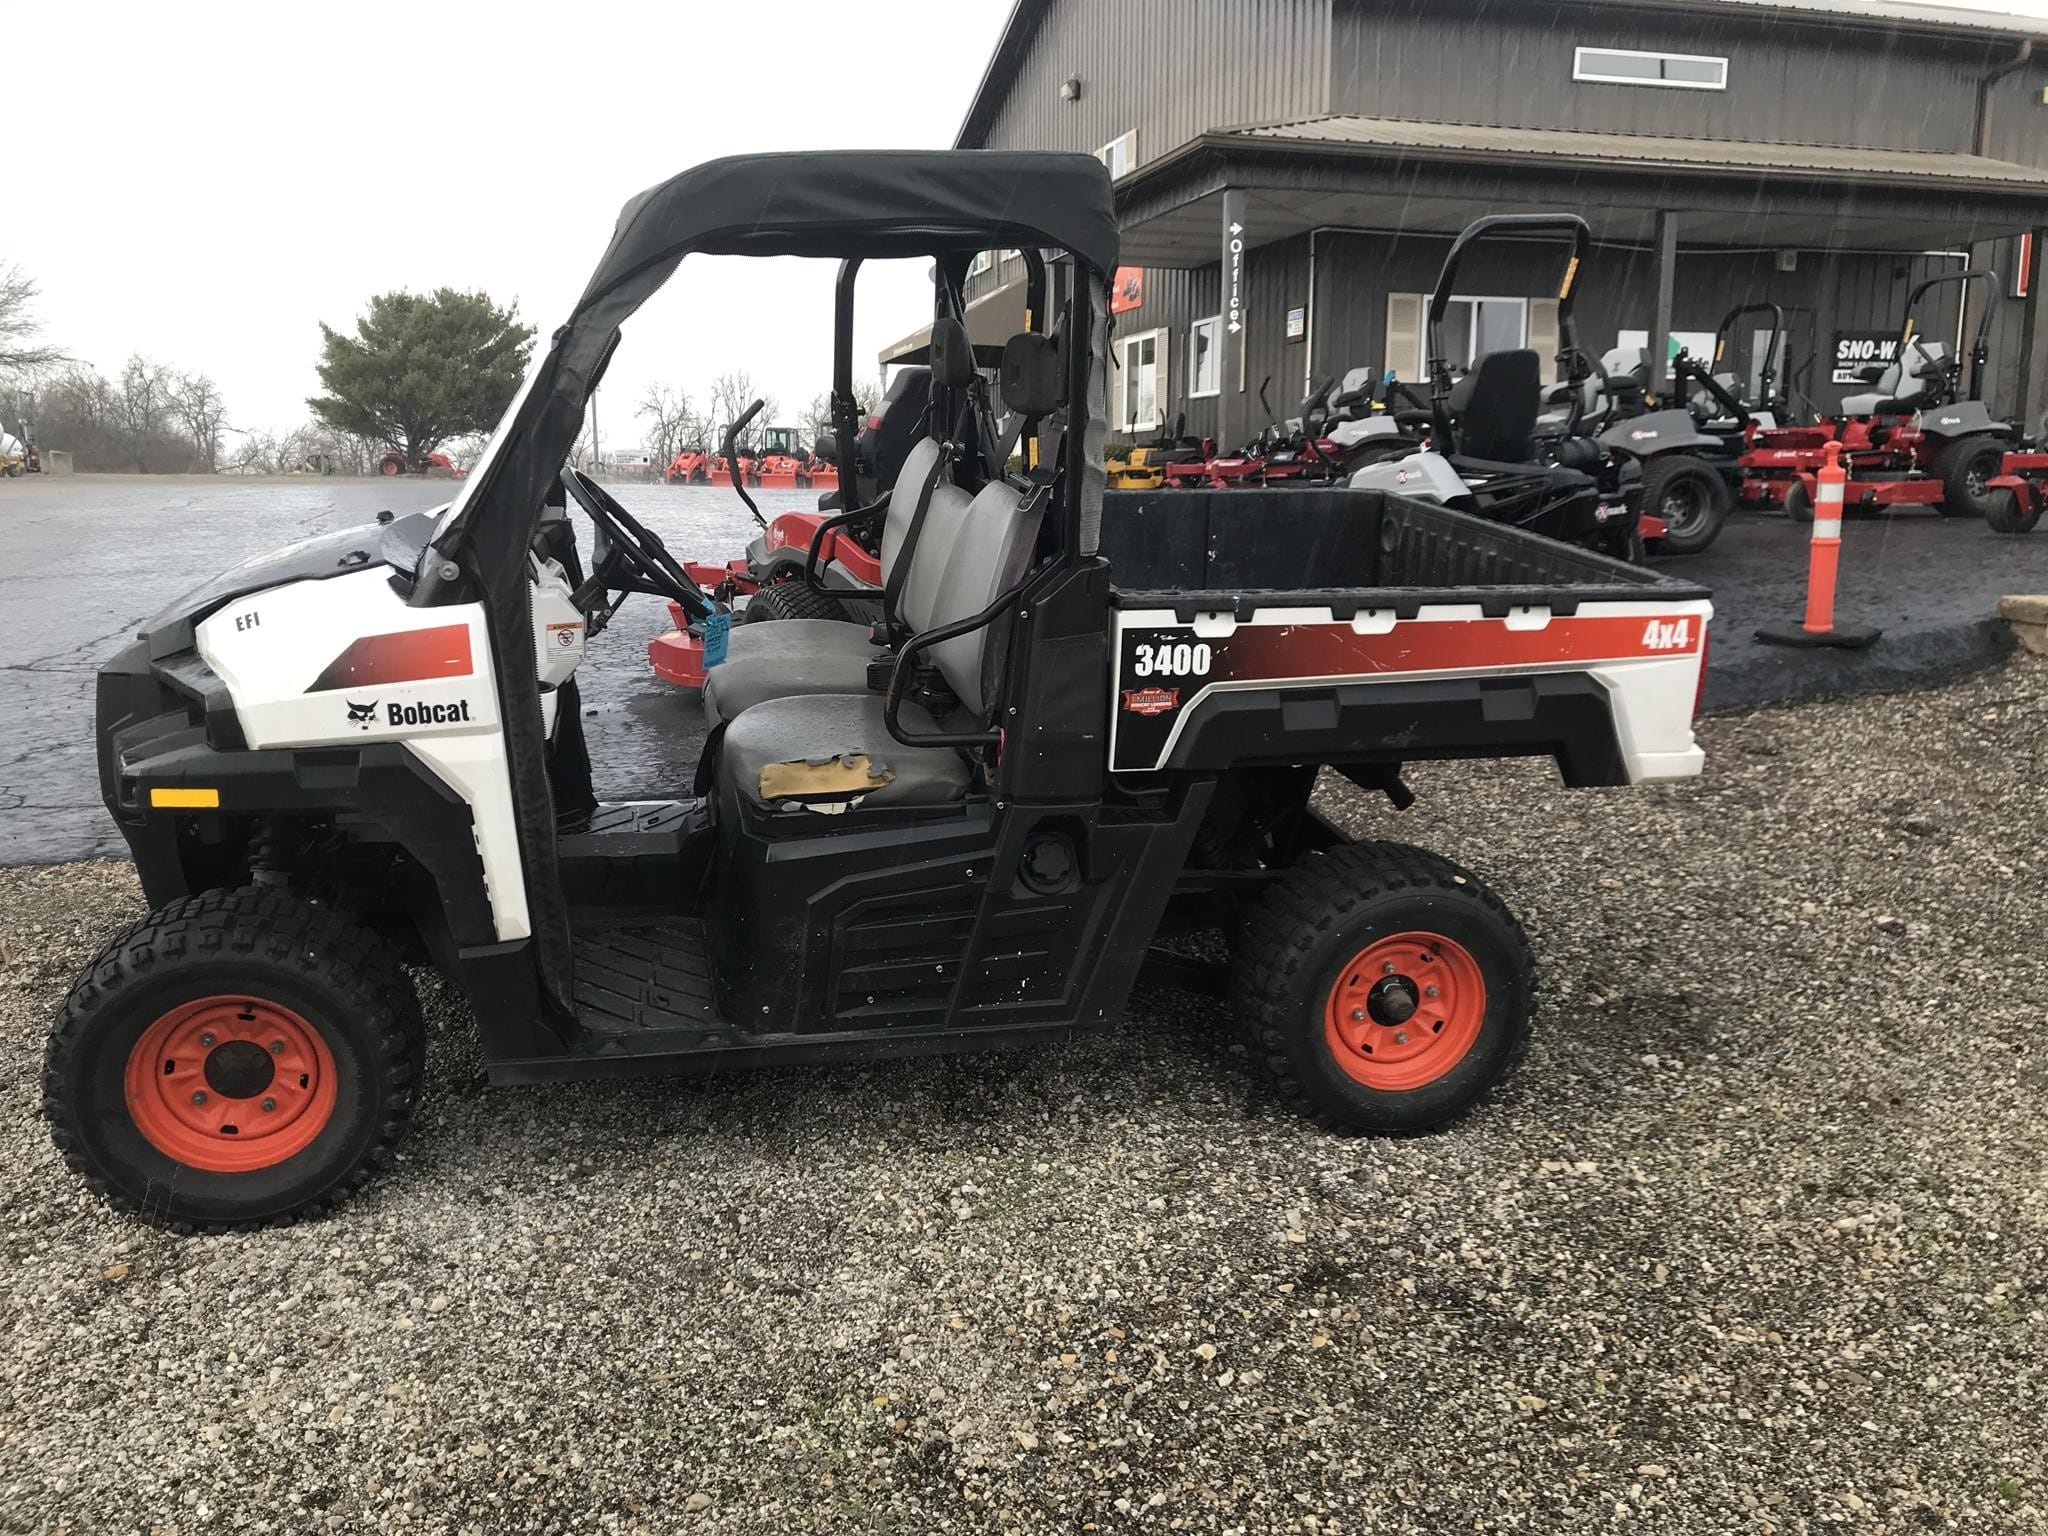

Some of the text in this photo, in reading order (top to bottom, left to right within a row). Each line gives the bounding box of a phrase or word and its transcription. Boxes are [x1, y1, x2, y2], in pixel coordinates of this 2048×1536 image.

[1230, 239, 1243, 320] Office
[1836, 335, 1916, 360] SNO-W
[236, 611, 260, 632] EFI
[1641, 618, 1690, 650] 4x4
[1134, 643, 1211, 676] 3400
[1136, 694, 1172, 703] MILLION
[387, 699, 470, 726] Bobcat
